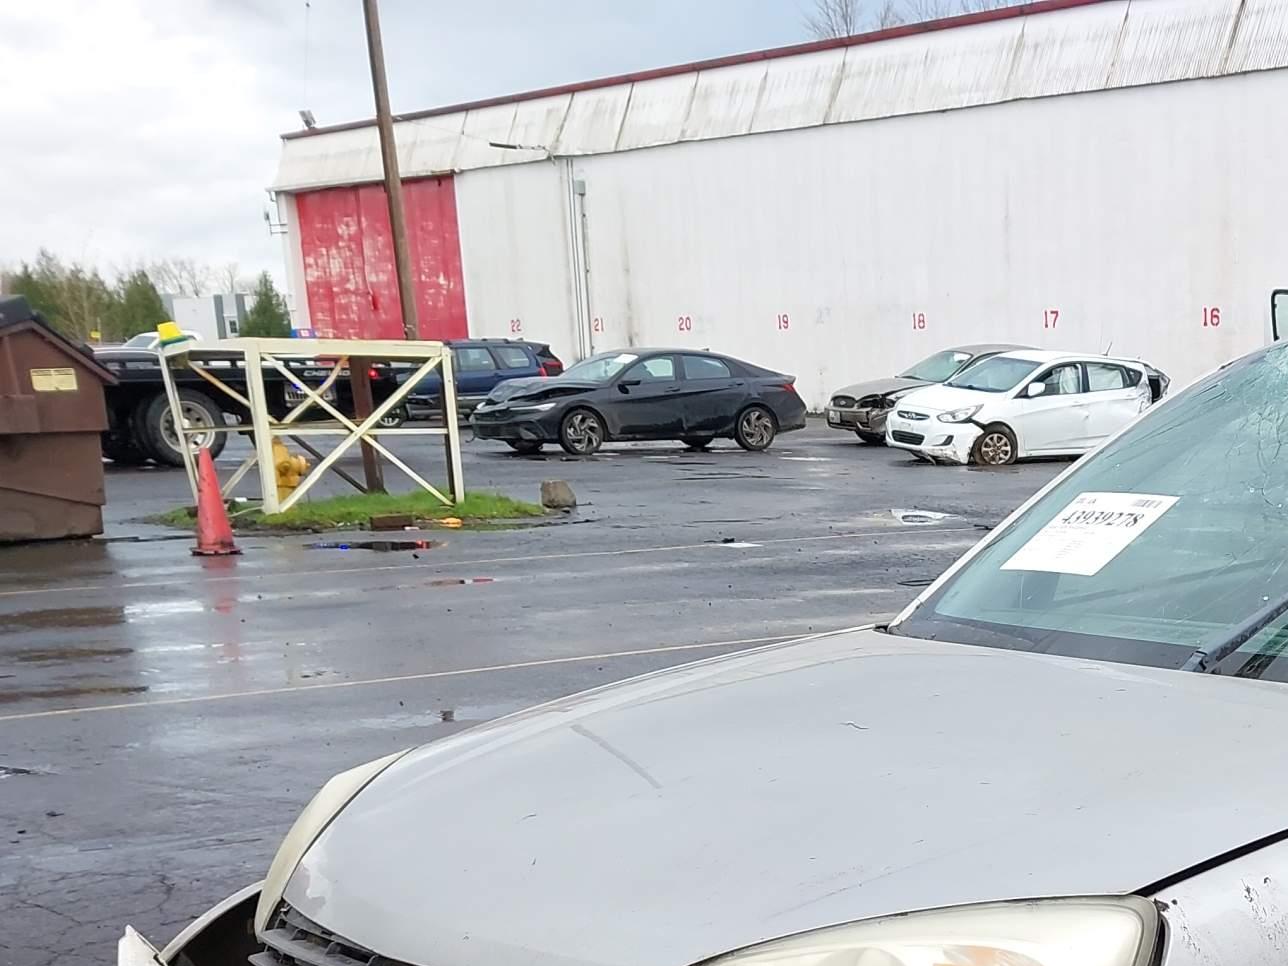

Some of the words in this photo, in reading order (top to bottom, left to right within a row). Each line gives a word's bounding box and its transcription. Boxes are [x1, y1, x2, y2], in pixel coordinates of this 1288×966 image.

[593, 317, 605, 332] 21
[678, 316, 692, 332] 20
[777, 314, 790, 330] 19
[912, 313, 926, 330] 18
[1044, 310, 1060, 329] 17
[1203, 307, 1221, 327] 16
[510, 319, 522, 333] 22
[1061, 510, 1145, 528] 43939278
